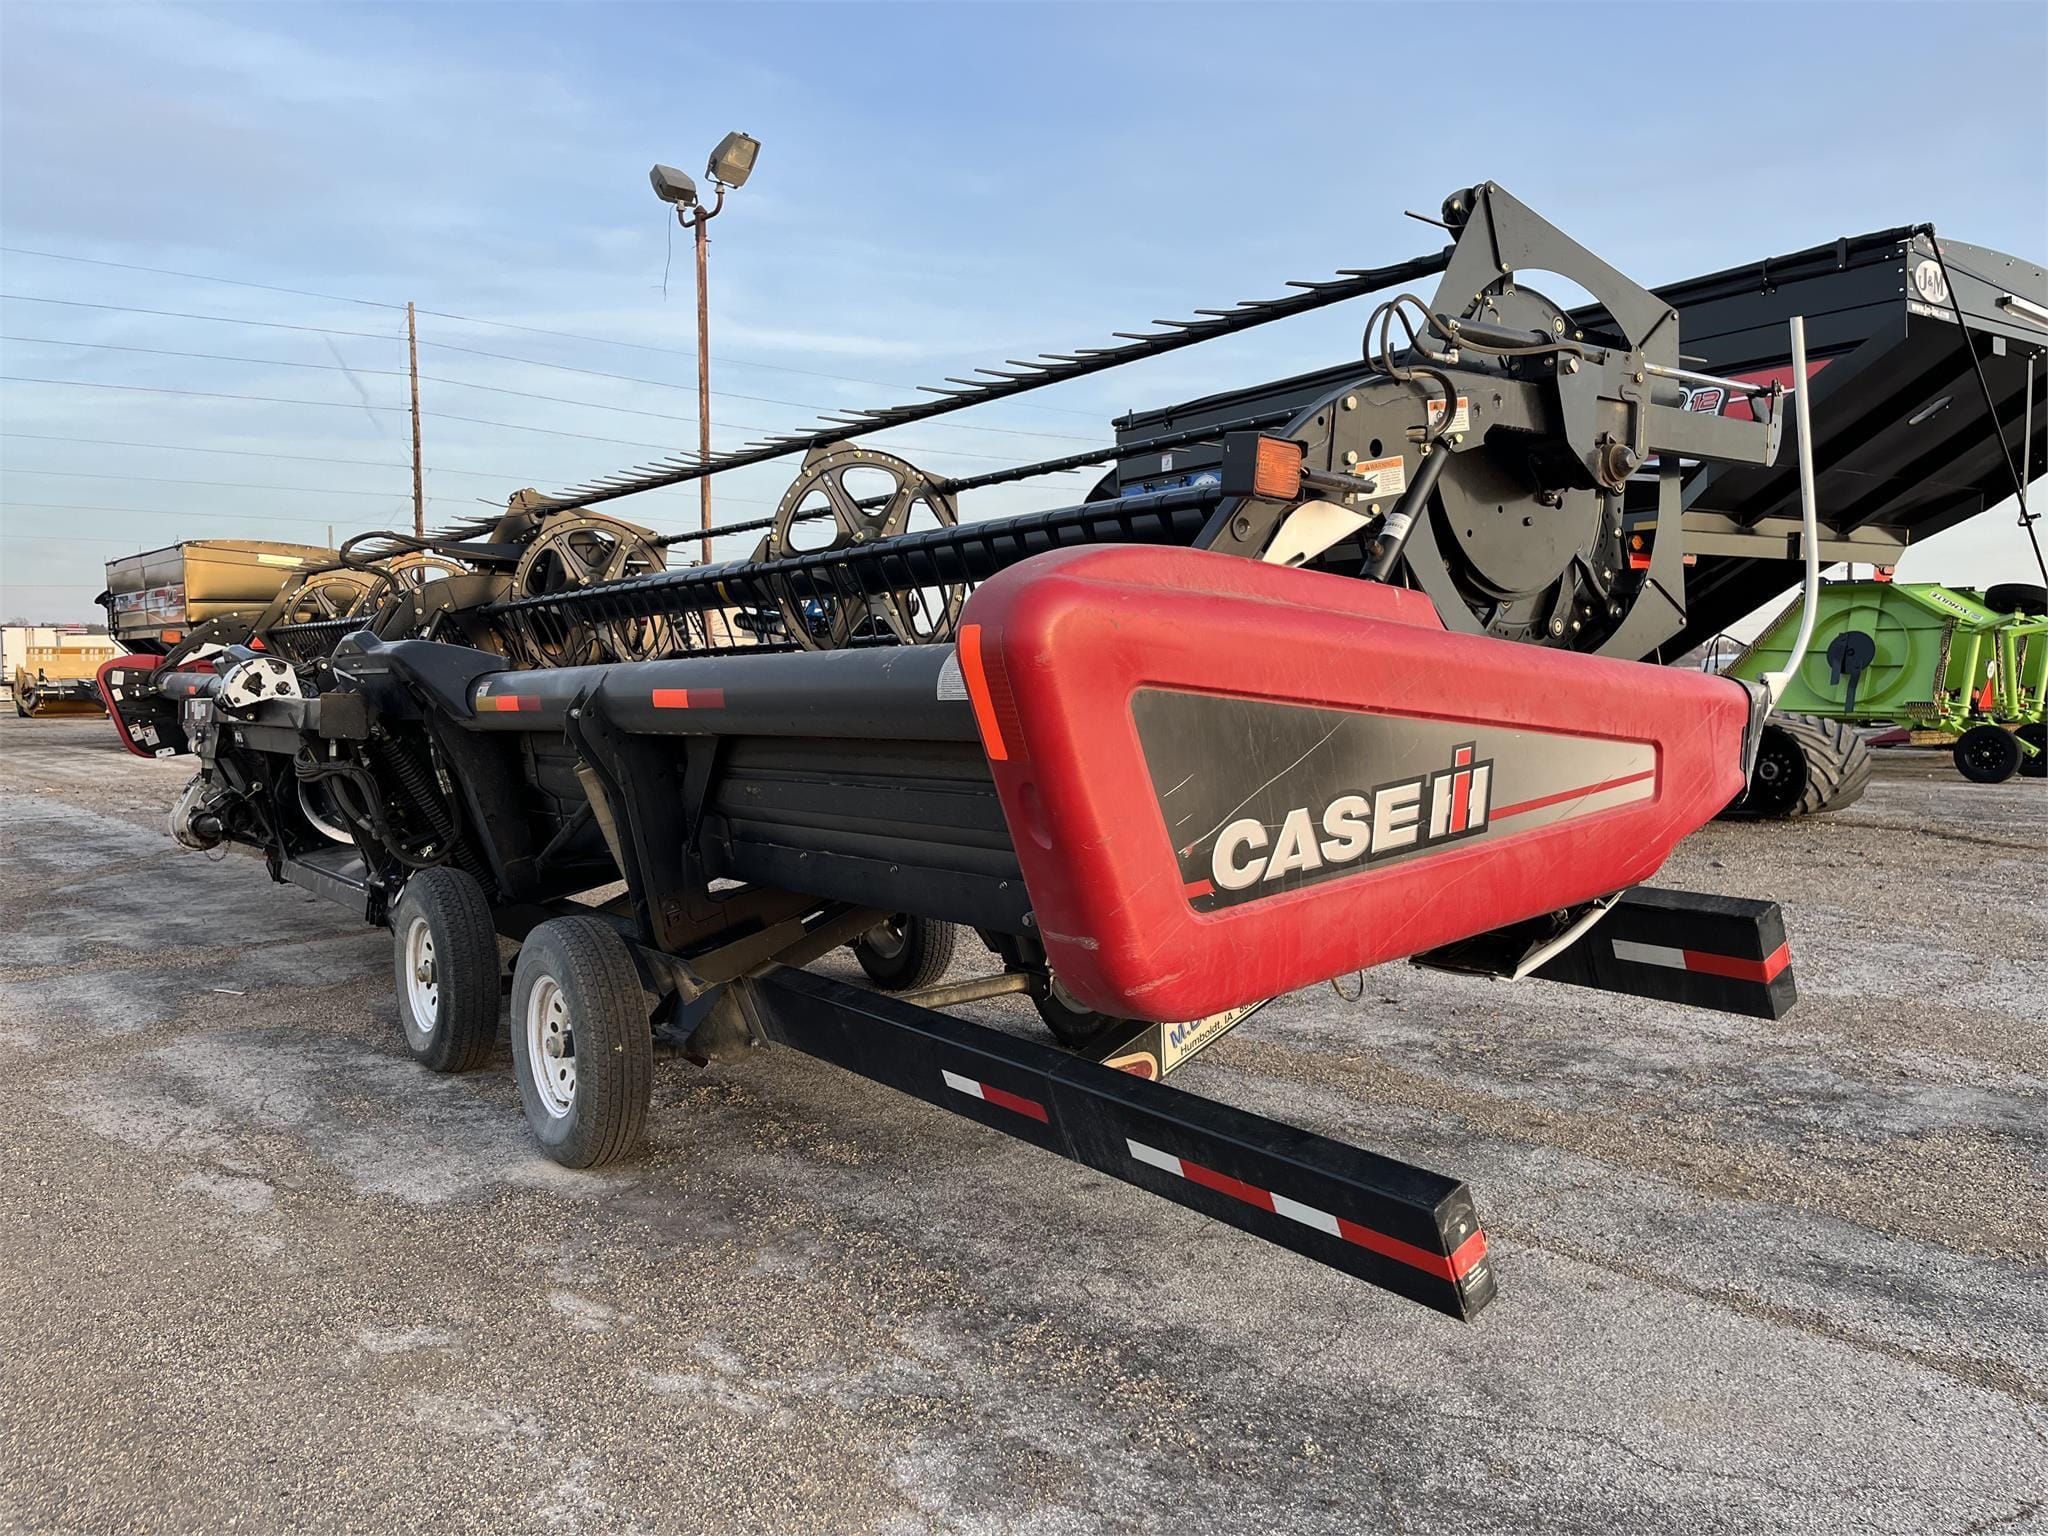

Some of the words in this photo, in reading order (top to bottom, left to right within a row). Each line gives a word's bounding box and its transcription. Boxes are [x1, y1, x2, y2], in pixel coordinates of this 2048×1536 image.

[1918, 267, 1945, 297] J&M
[1679, 389, 1721, 413] 12
[1931, 591, 1969, 614] SCHULTE
[1211, 781, 1422, 891] CASE
[1224, 1012, 1233, 1024] IA
